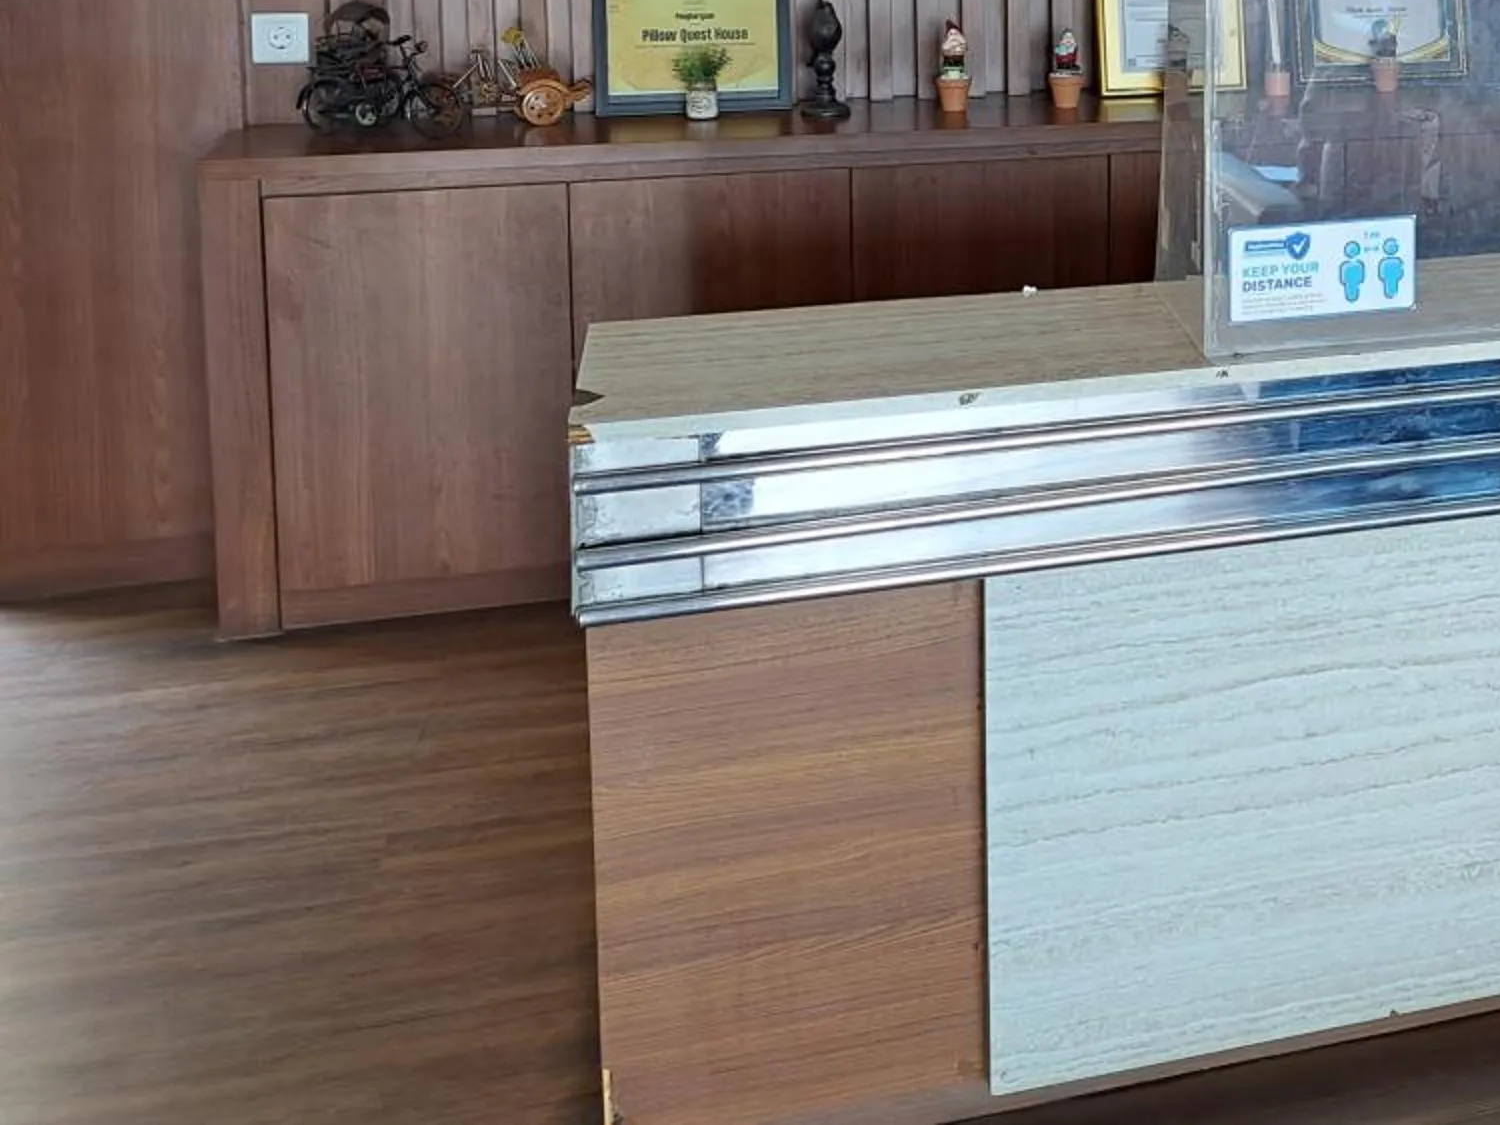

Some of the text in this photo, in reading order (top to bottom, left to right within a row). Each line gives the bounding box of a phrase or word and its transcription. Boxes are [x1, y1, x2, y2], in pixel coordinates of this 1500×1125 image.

[641, 28, 677, 42] Pillow
[714, 27, 749, 40] House
[1243, 261, 1319, 278] KEEP YOUR
[1242, 275, 1312, 292] DISTANCE
